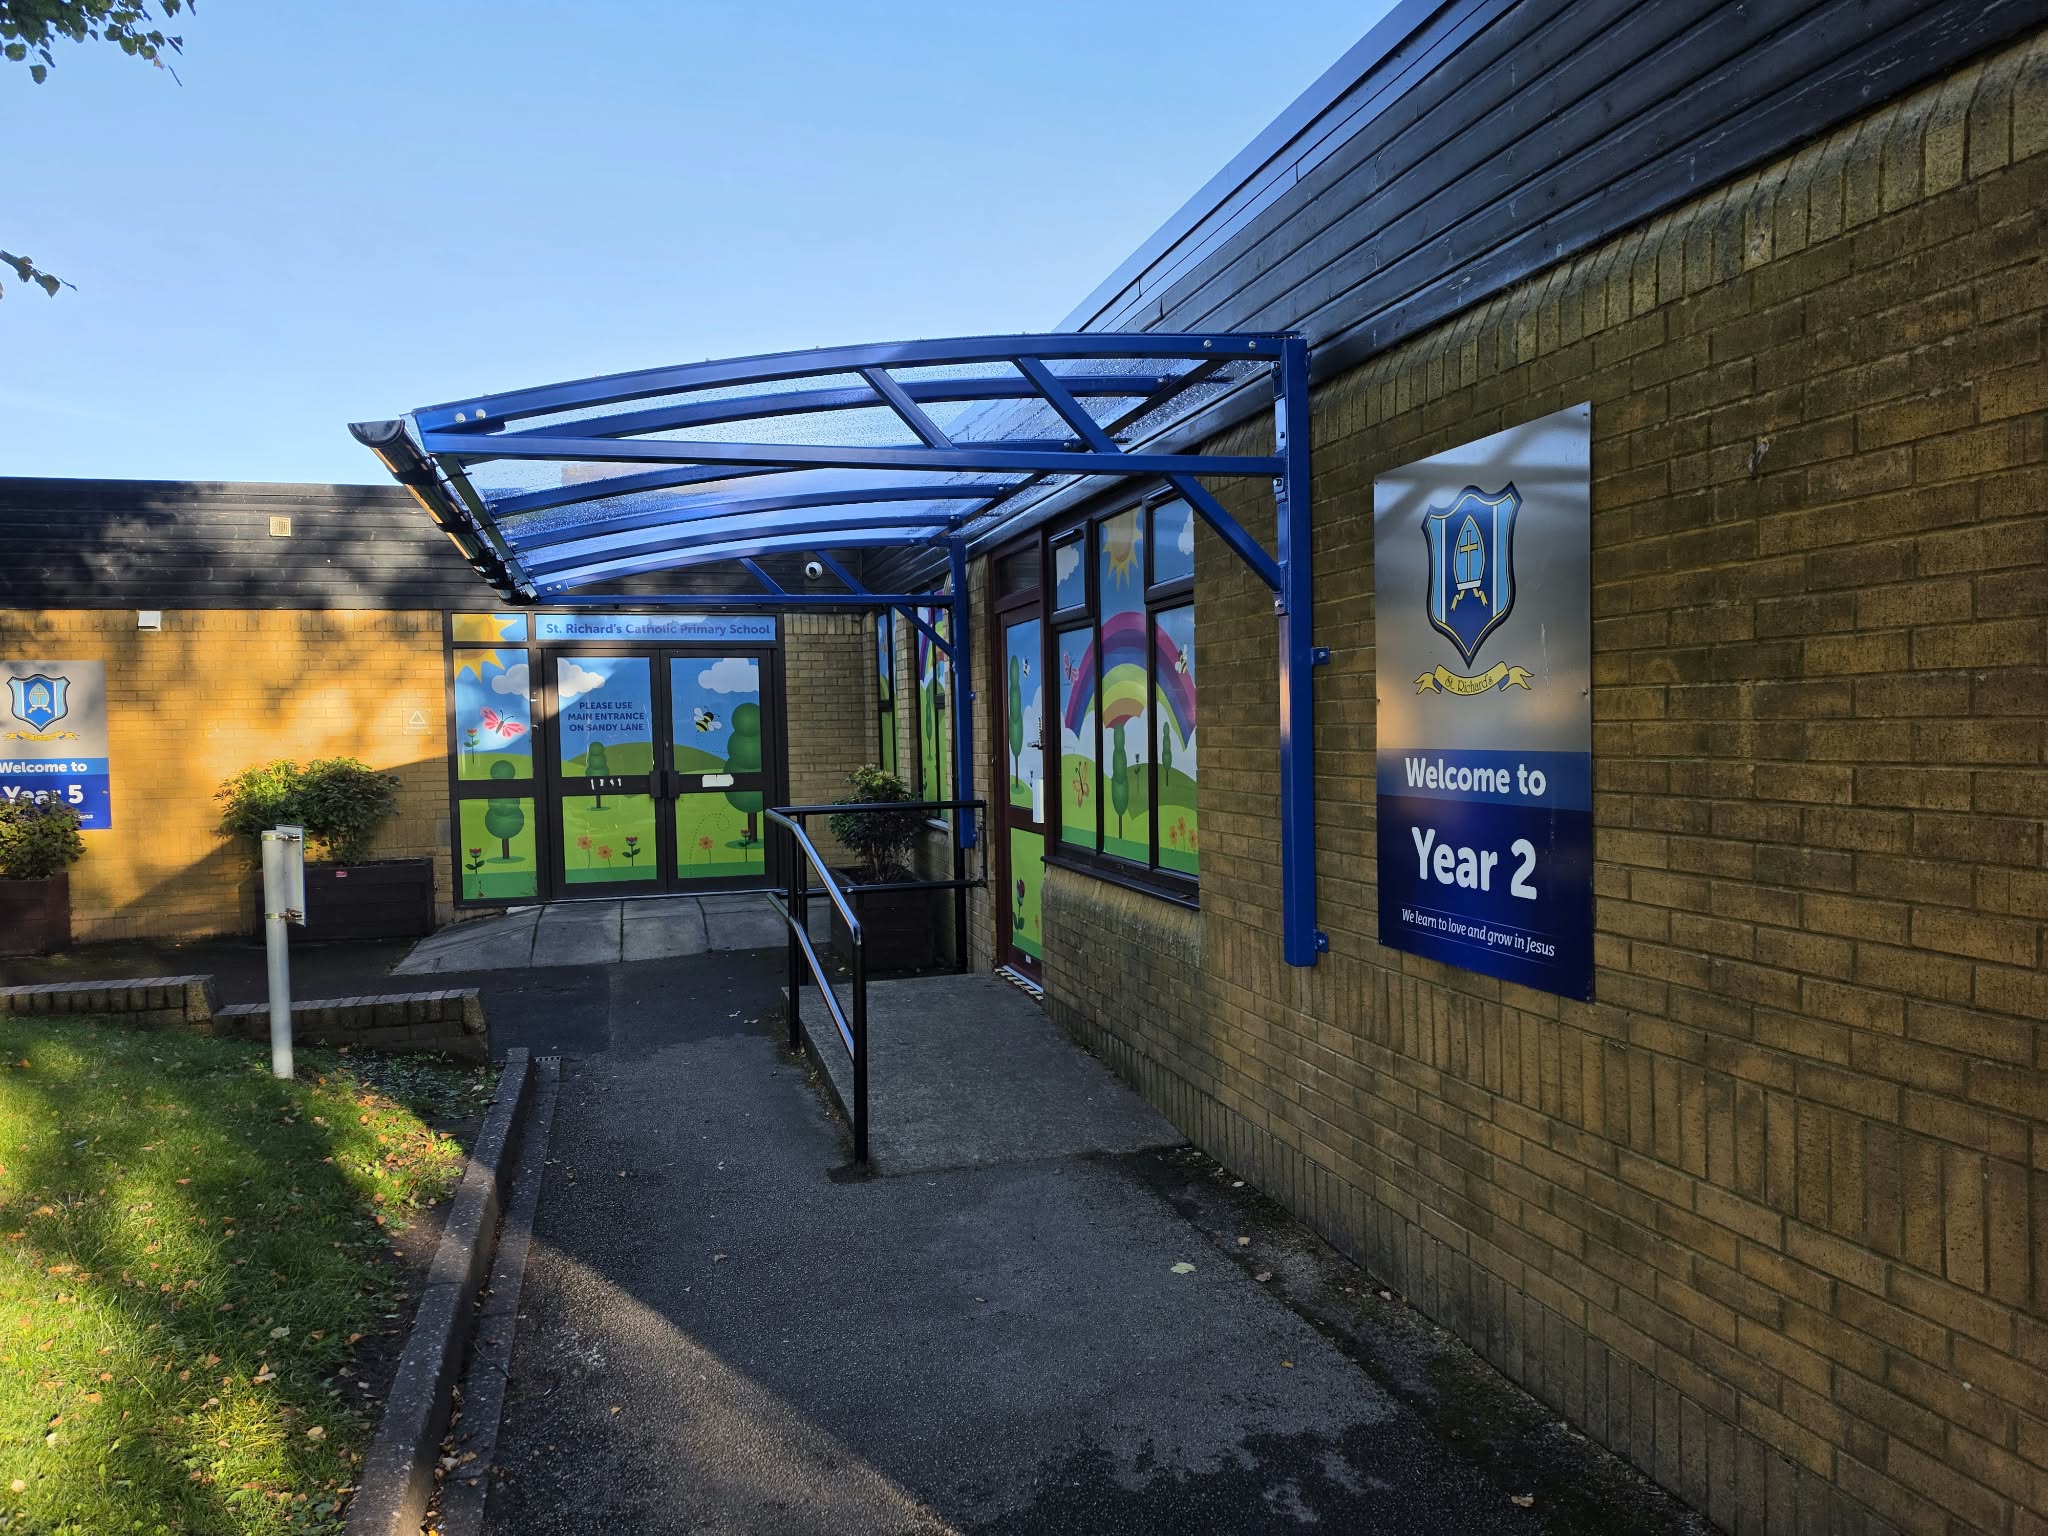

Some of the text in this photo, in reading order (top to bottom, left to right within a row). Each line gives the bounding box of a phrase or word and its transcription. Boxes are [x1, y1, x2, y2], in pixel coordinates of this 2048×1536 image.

[545, 623, 771, 637] St. Richard's Catholic Primary School
[1457, 674, 1494, 693] Richard's
[579, 701, 633, 710] PLEASE USE
[568, 712, 645, 721] MAIN ENTRANCE
[569, 723, 645, 732] ON SANDY LANE
[0, 761, 88, 774] Welcome to
[1405, 757, 1547, 796] Welcome to
[68, 784, 84, 804] 5
[1411, 826, 1538, 900] Year 2
[1402, 908, 1556, 957] We learn to love and grow in Jesus
